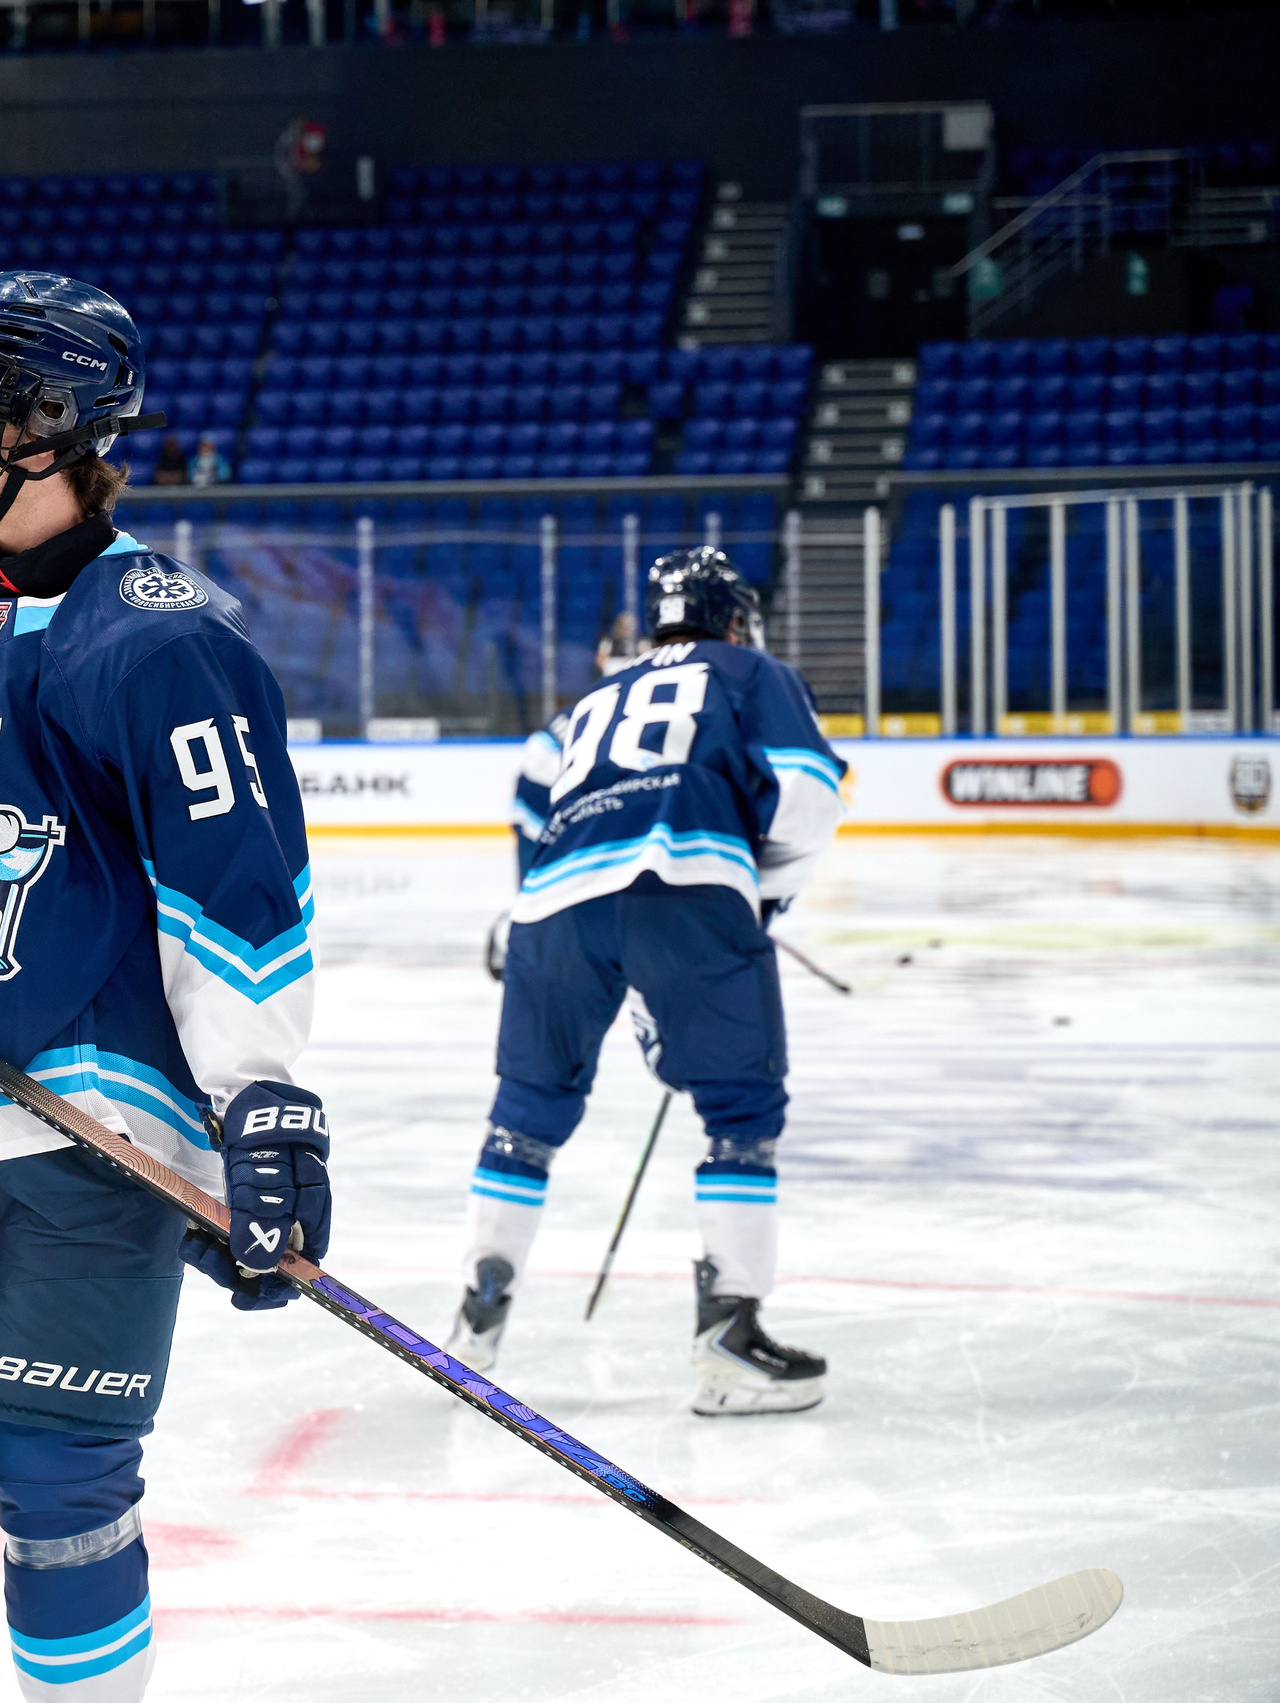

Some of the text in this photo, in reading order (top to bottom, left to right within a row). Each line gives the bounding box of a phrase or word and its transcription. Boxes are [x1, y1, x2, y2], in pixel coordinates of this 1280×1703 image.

[61, 351, 109, 372] CCM
[169, 714, 269, 821] 95
[550, 662, 711, 804] 98
